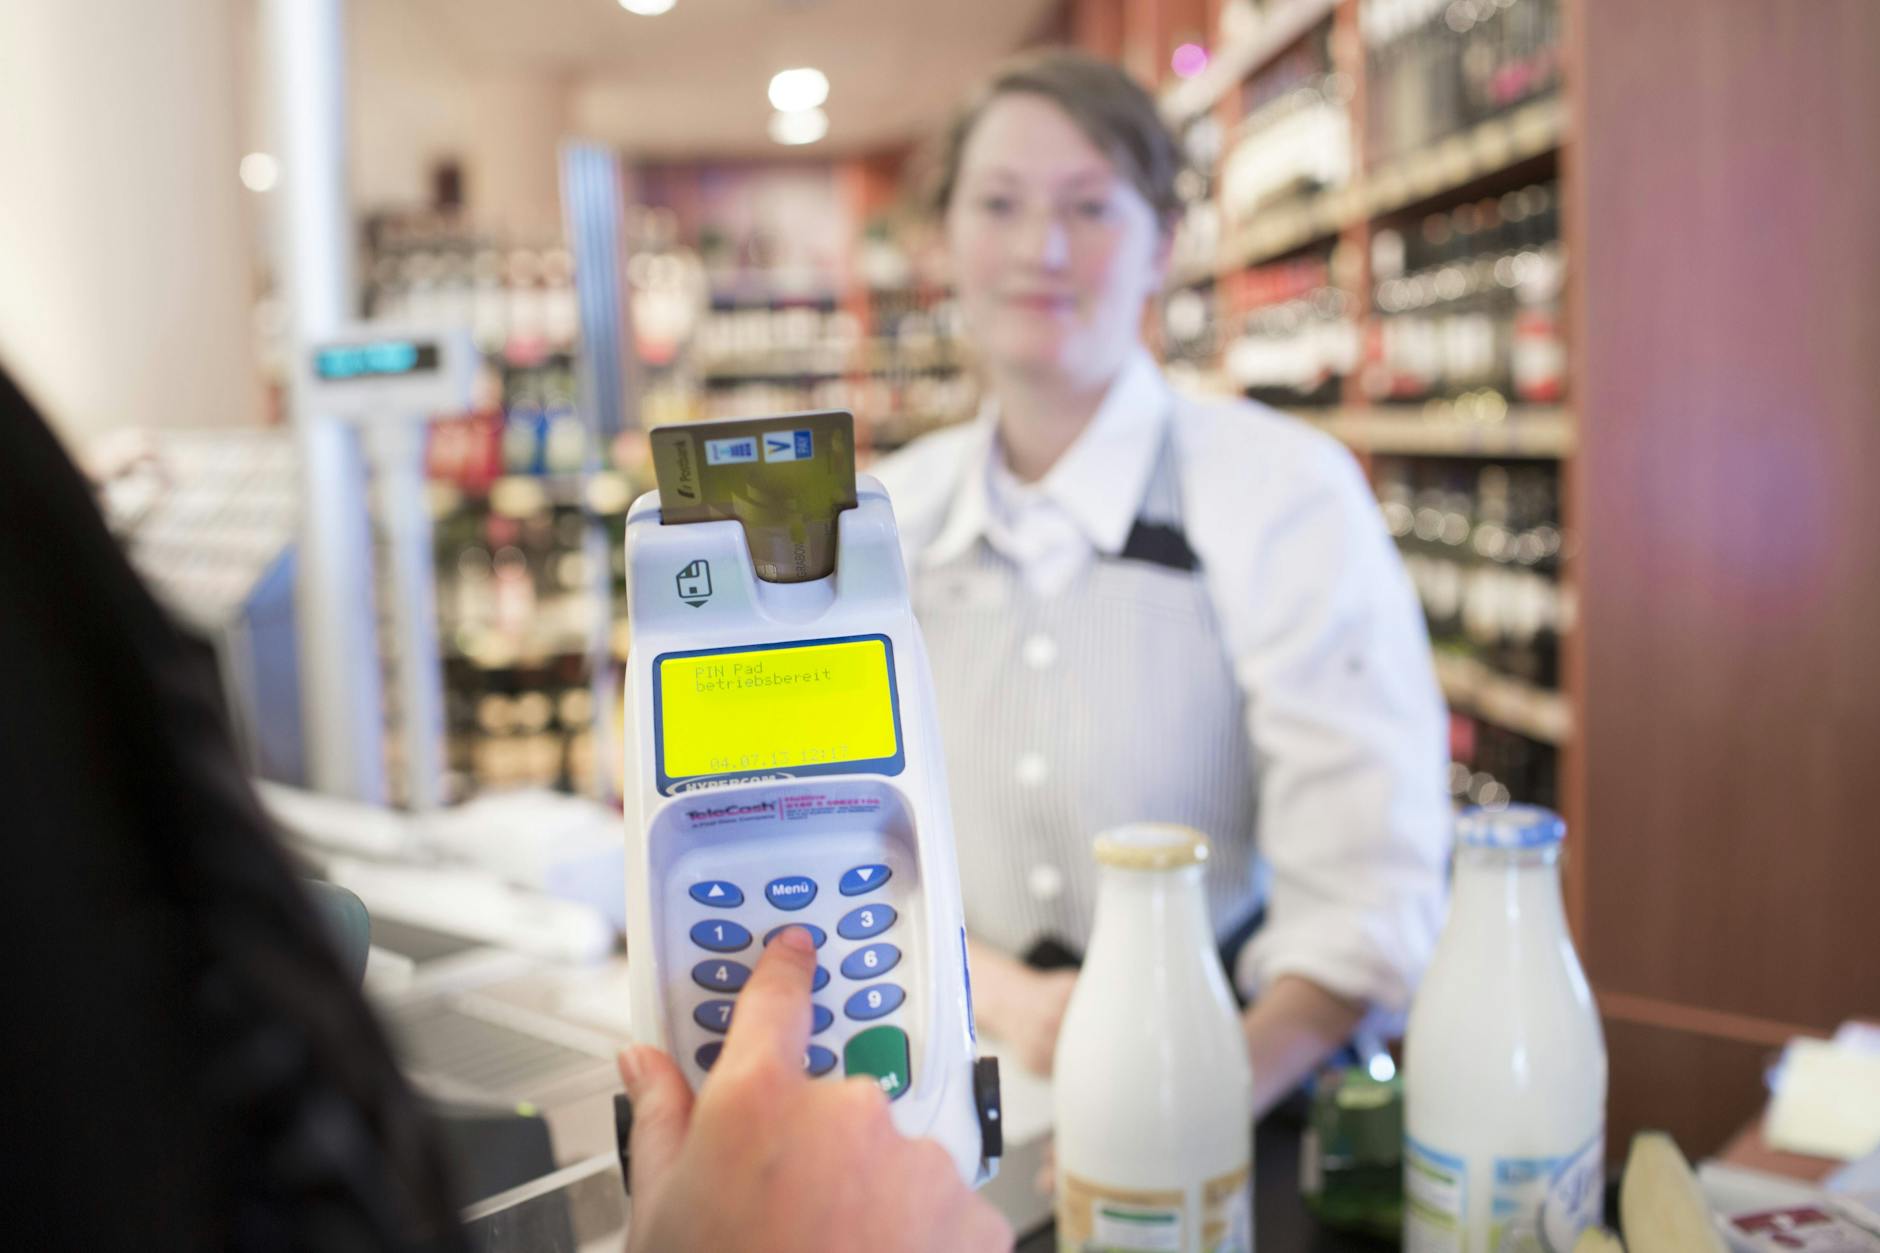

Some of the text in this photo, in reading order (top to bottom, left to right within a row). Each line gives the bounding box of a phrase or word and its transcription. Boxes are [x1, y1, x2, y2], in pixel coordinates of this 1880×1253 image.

[675, 440, 691, 482] Postbank
[695, 662, 763, 679] PIN Pad
[695, 669, 832, 692] betriebsbereit
[686, 802, 775, 821] TeleCash
[772, 881, 810, 897] Menü
[860, 910, 875, 928] 3
[713, 925, 724, 942] 1
[863, 950, 878, 968] 6
[715, 965, 729, 982] 4
[867, 990, 883, 1009] 9
[718, 1007, 731, 1023] 7
